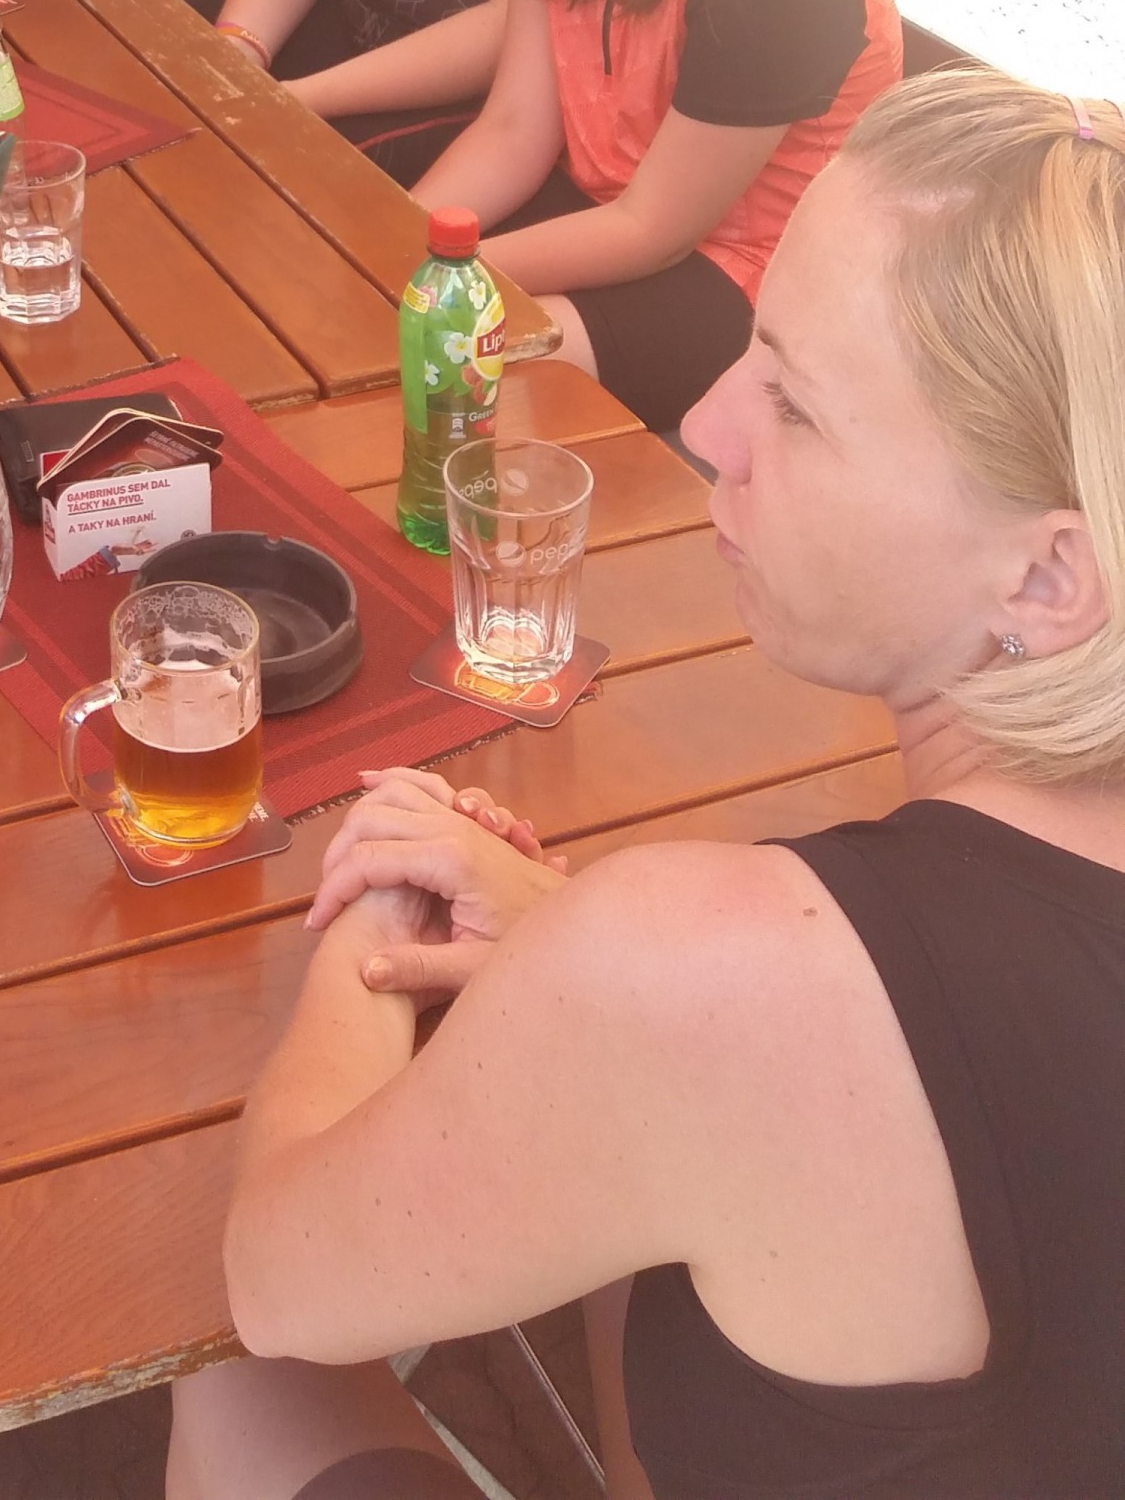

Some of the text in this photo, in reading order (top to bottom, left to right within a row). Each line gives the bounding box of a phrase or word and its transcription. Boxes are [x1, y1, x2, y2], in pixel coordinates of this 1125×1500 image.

[67, 479, 171, 503] GAMBRINUS SEM DAL
[102, 498, 117, 507] NA
[118, 494, 144, 506] PIVO.
[68, 510, 157, 534] A TAKY NA HRANÍ.
[530, 542, 571, 565] pep
